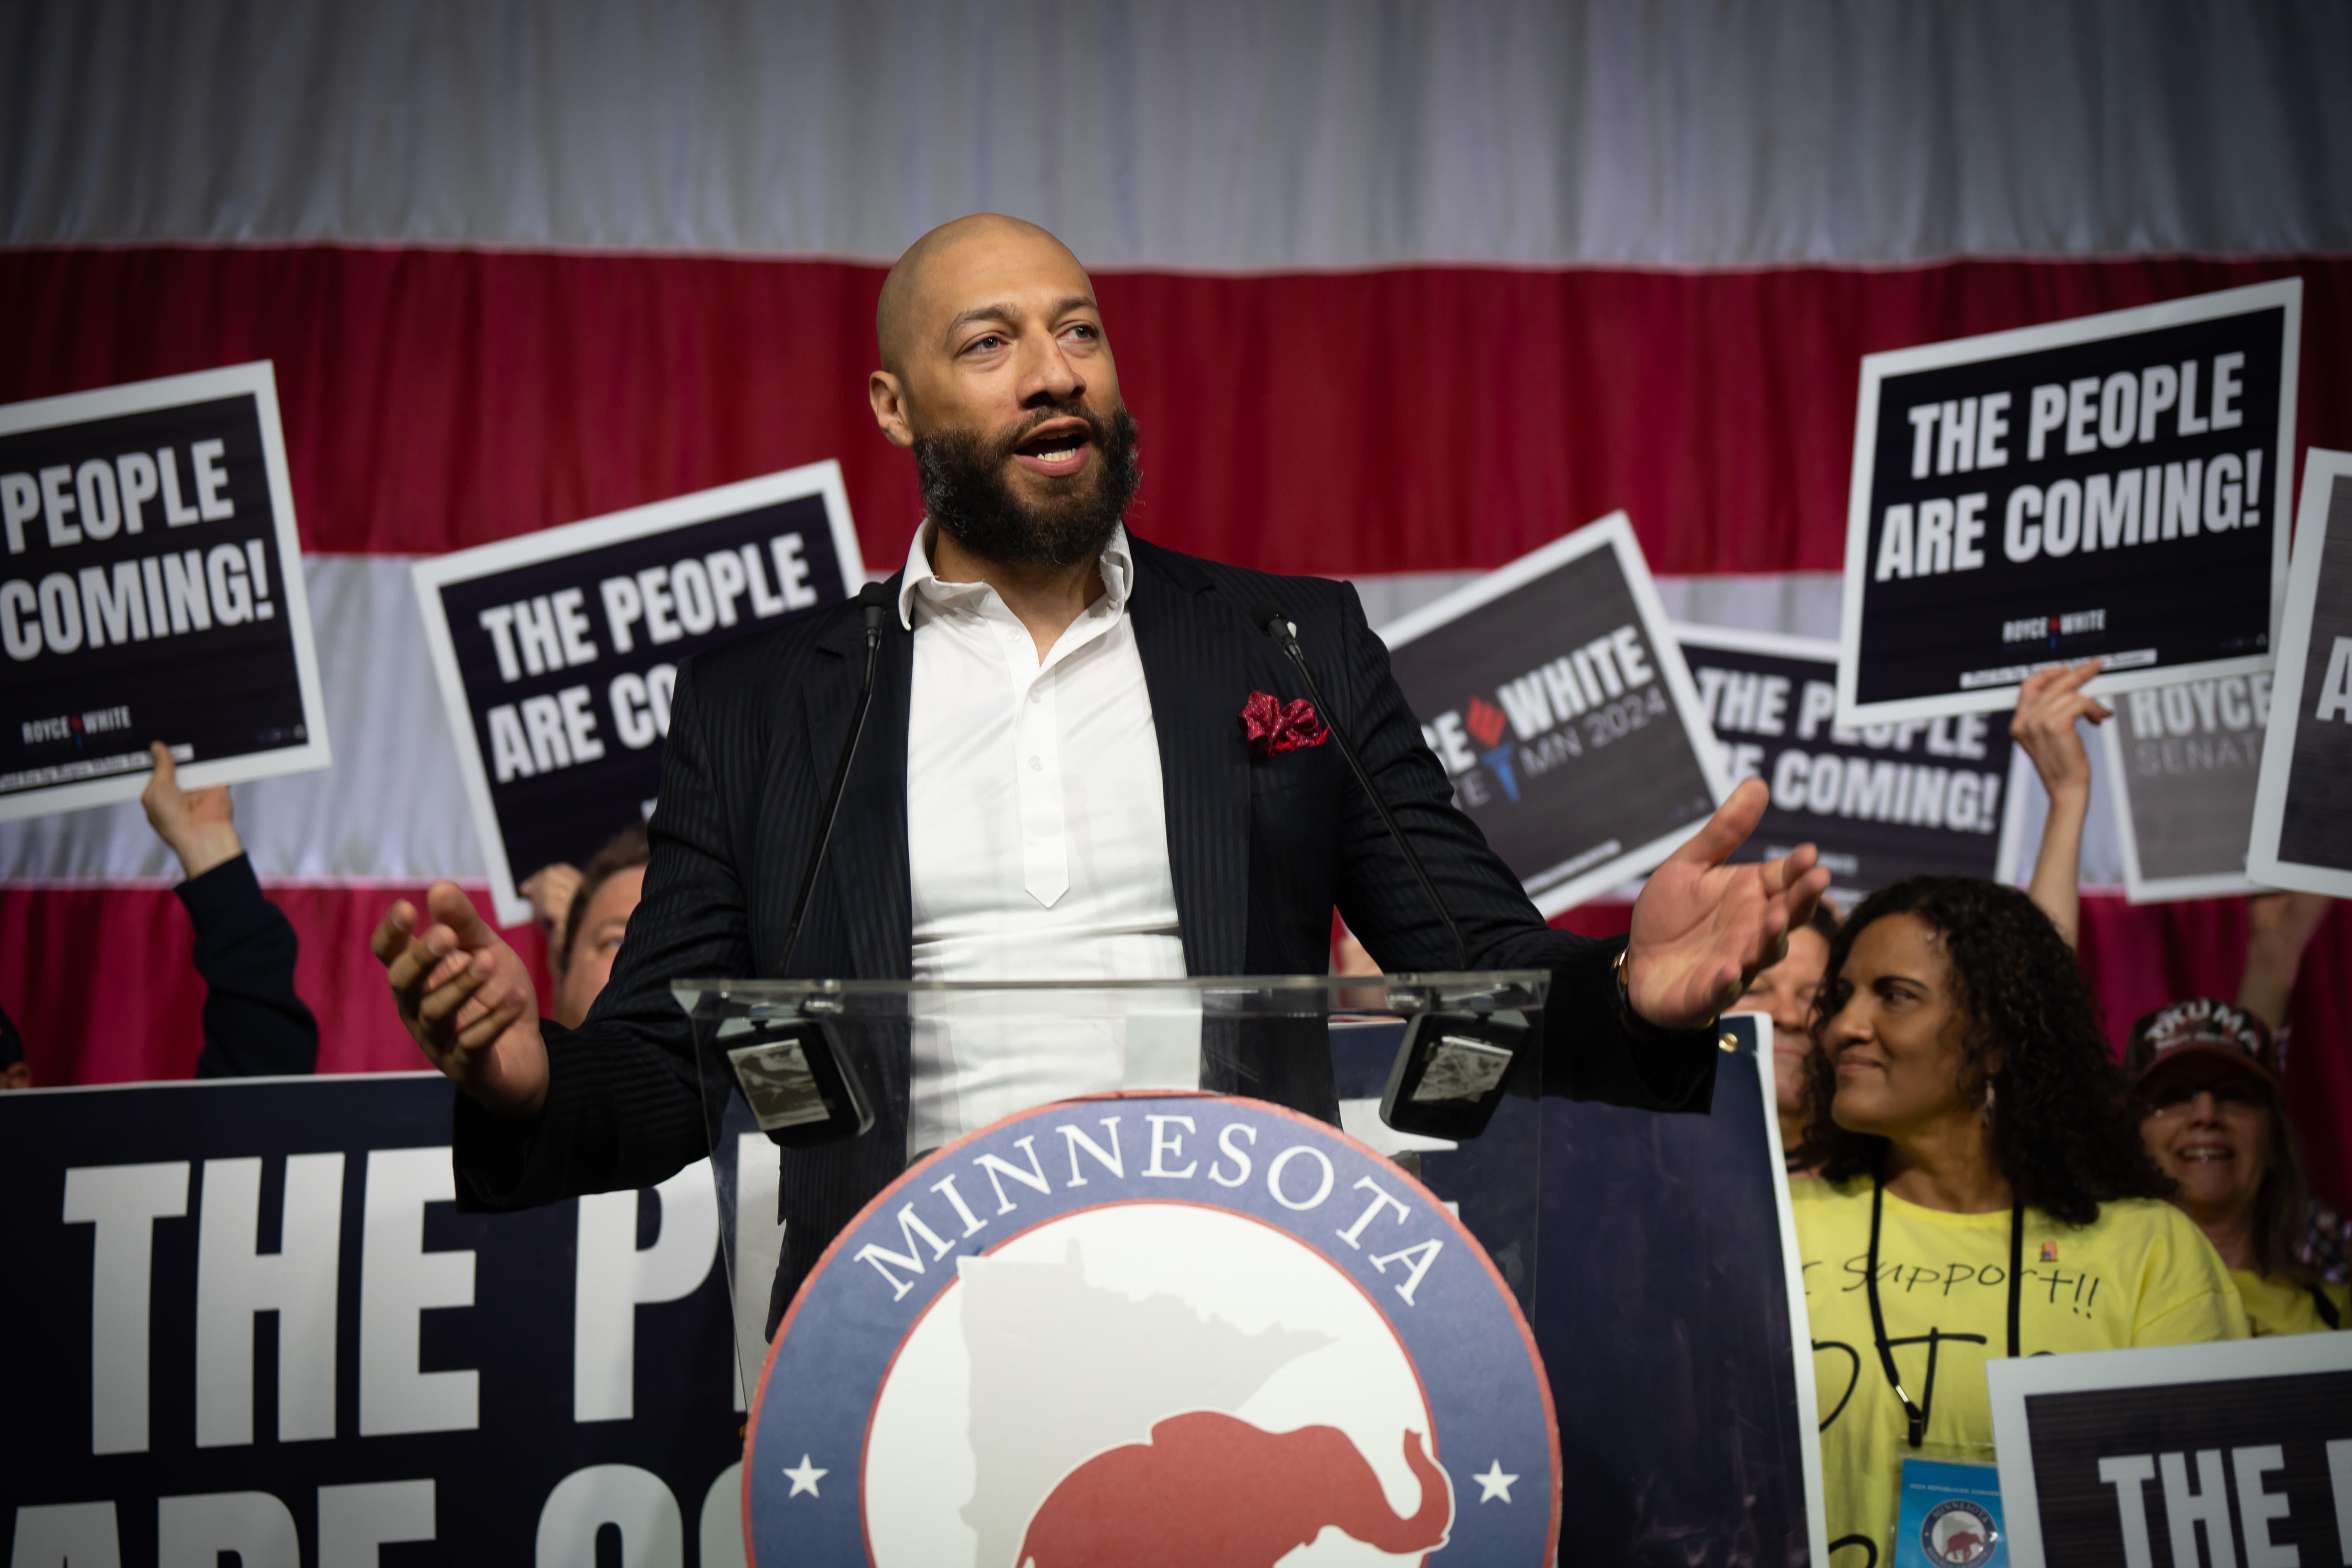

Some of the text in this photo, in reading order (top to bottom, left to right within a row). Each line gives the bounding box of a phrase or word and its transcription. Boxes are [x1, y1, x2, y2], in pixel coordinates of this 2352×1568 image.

[1908, 351, 2245, 479] THE PEOPLE
[0, 438, 235, 554] PEOPLE
[1875, 449, 2263, 581] ARE COMING!
[1, 539, 274, 661] COMING!
[479, 533, 818, 682] THE PEOPLE
[2003, 609, 2106, 643] ROYCE WHITE
[22, 706, 132, 744] ROYCE WHITE
[488, 685, 605, 783] ARE
[1497, 625, 1654, 740] WHITE
[1519, 726, 1584, 778] MN
[1582, 685, 1667, 748] 2024
[1697, 667, 1790, 737] THE
[1771, 749, 2001, 834] COMING!
[853, 1114, 1444, 1307] MINNESOTA
[63, 1146, 479, 1454] THE
[2098, 1444, 2300, 1568] THE
